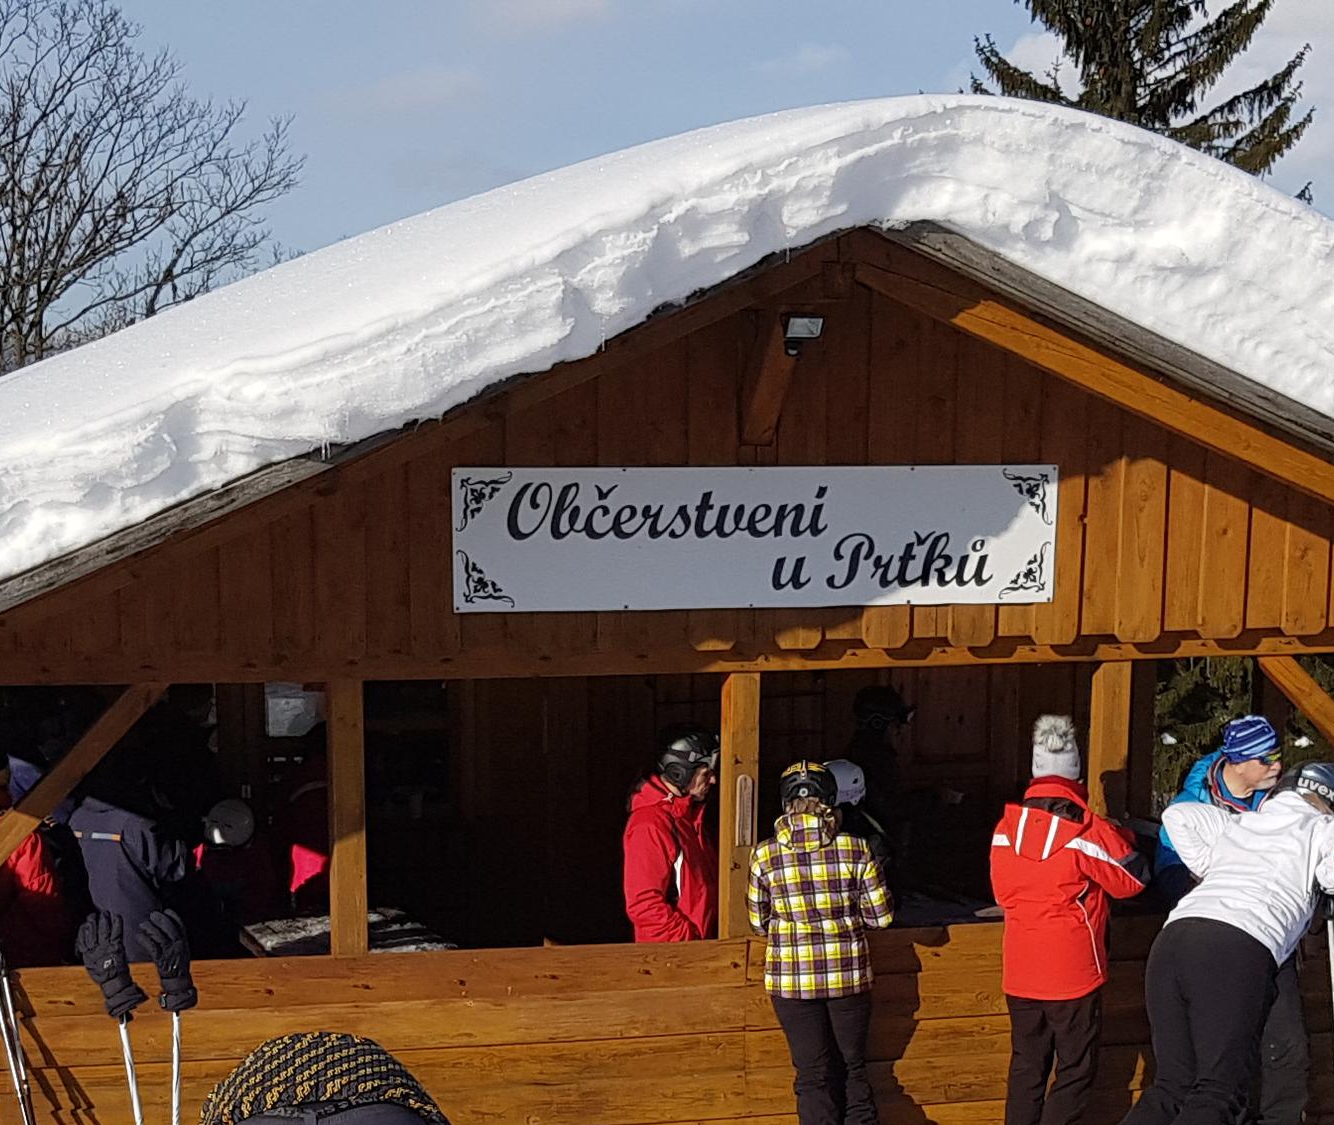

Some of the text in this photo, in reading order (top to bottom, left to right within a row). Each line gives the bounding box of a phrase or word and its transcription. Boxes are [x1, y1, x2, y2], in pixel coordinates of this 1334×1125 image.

[507, 482, 829, 541] Občerstvení
[771, 531, 994, 591] u Prťků
